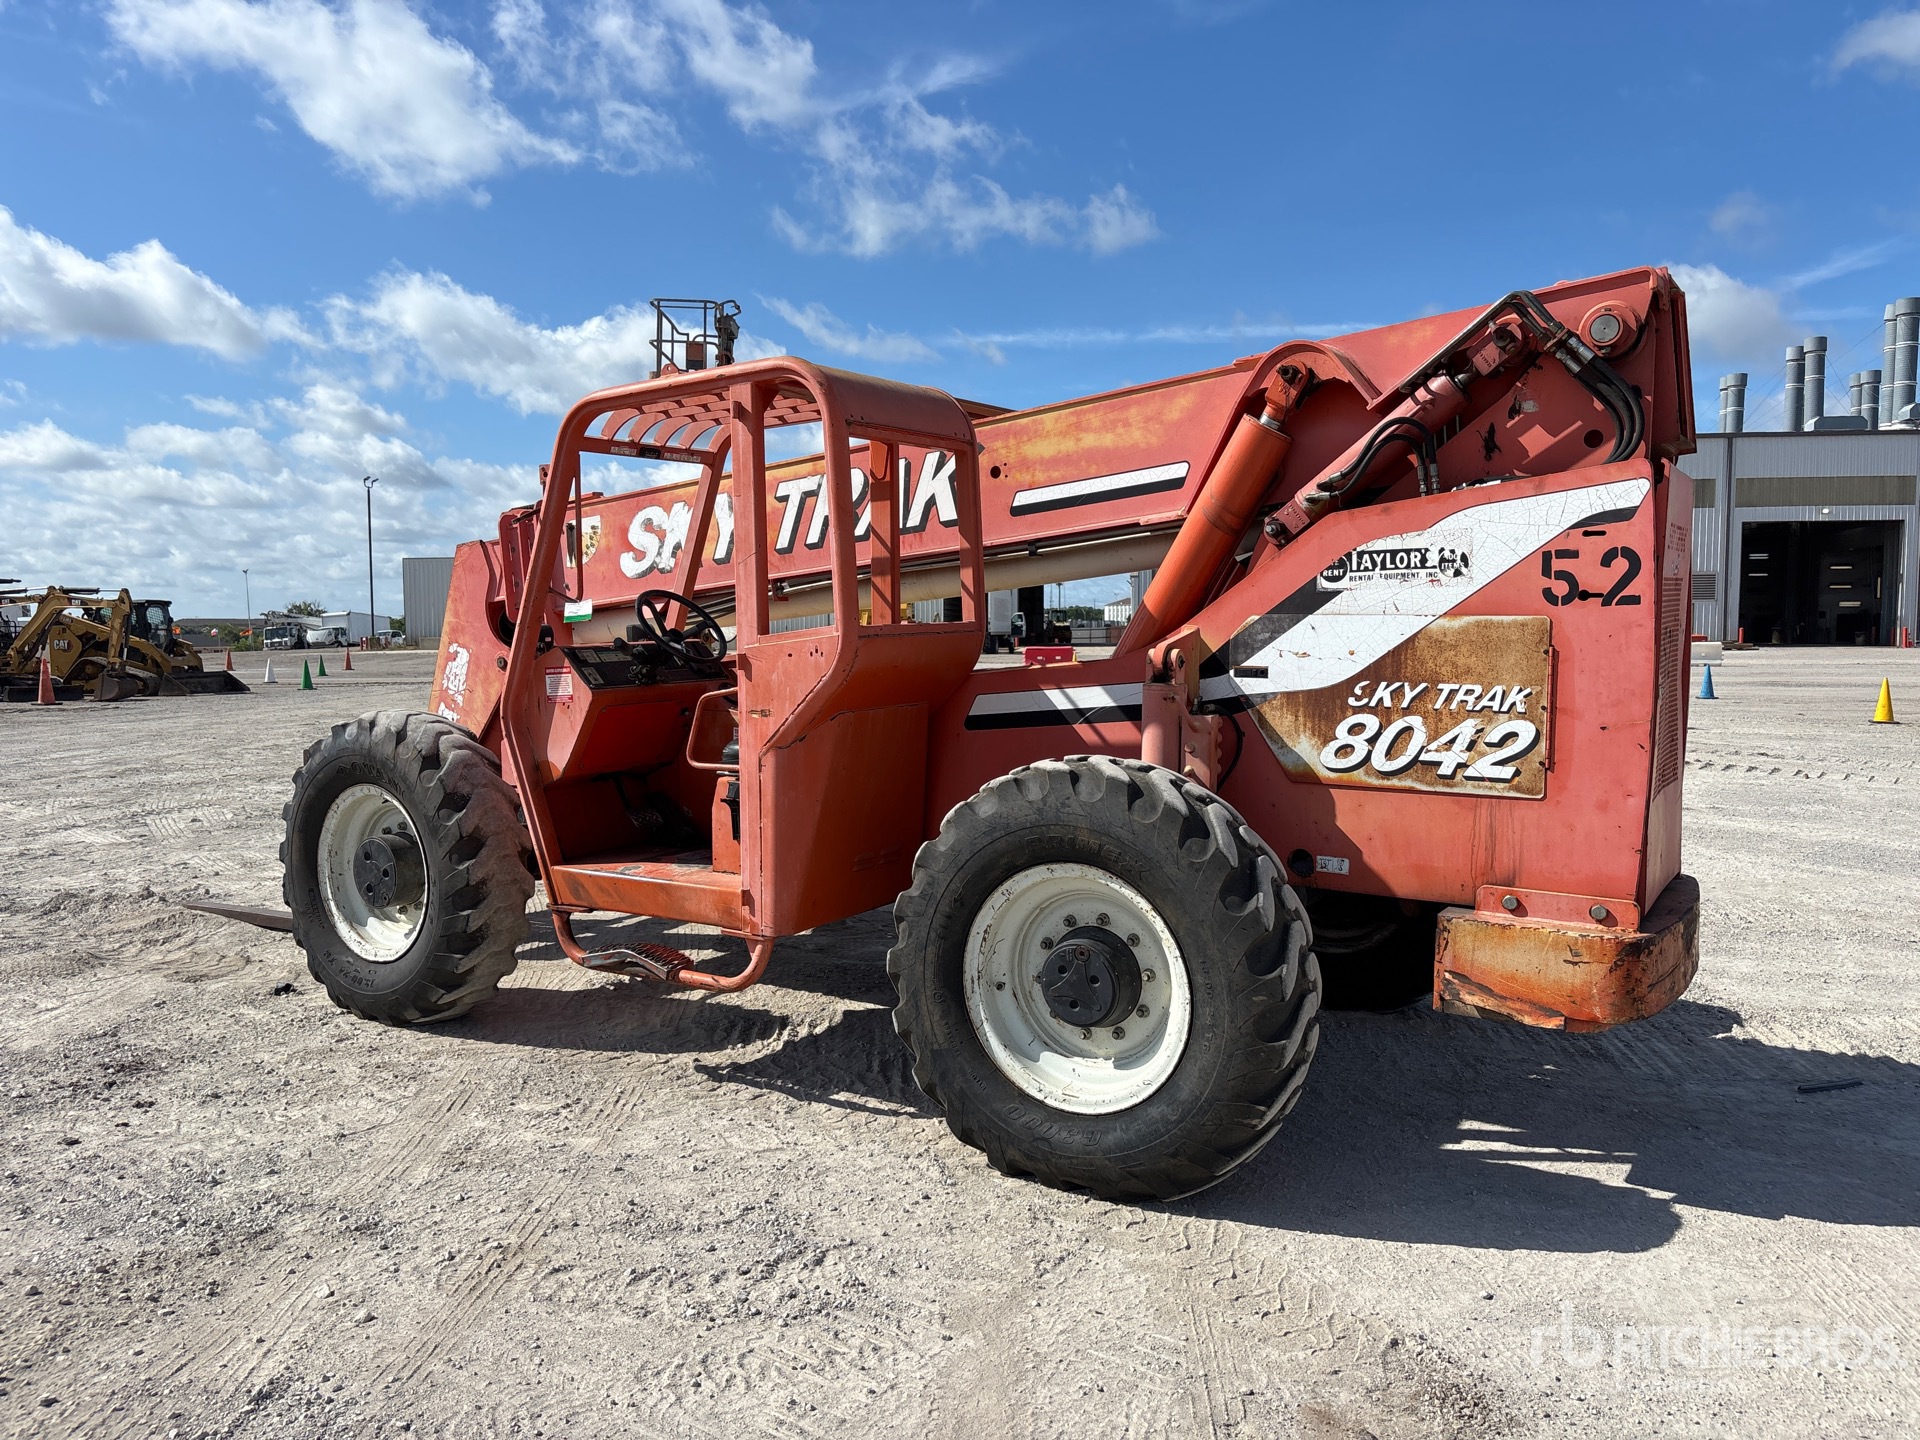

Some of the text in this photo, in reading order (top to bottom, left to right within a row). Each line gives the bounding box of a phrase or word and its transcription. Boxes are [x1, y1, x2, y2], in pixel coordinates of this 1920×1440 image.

[1441, 562, 1465, 570] ITEMS
[1322, 569, 1345, 577] RENT
[53, 640, 69, 650] CAT
[1347, 680, 1533, 714] SKY TRAK
[1319, 713, 1541, 784] 8042
